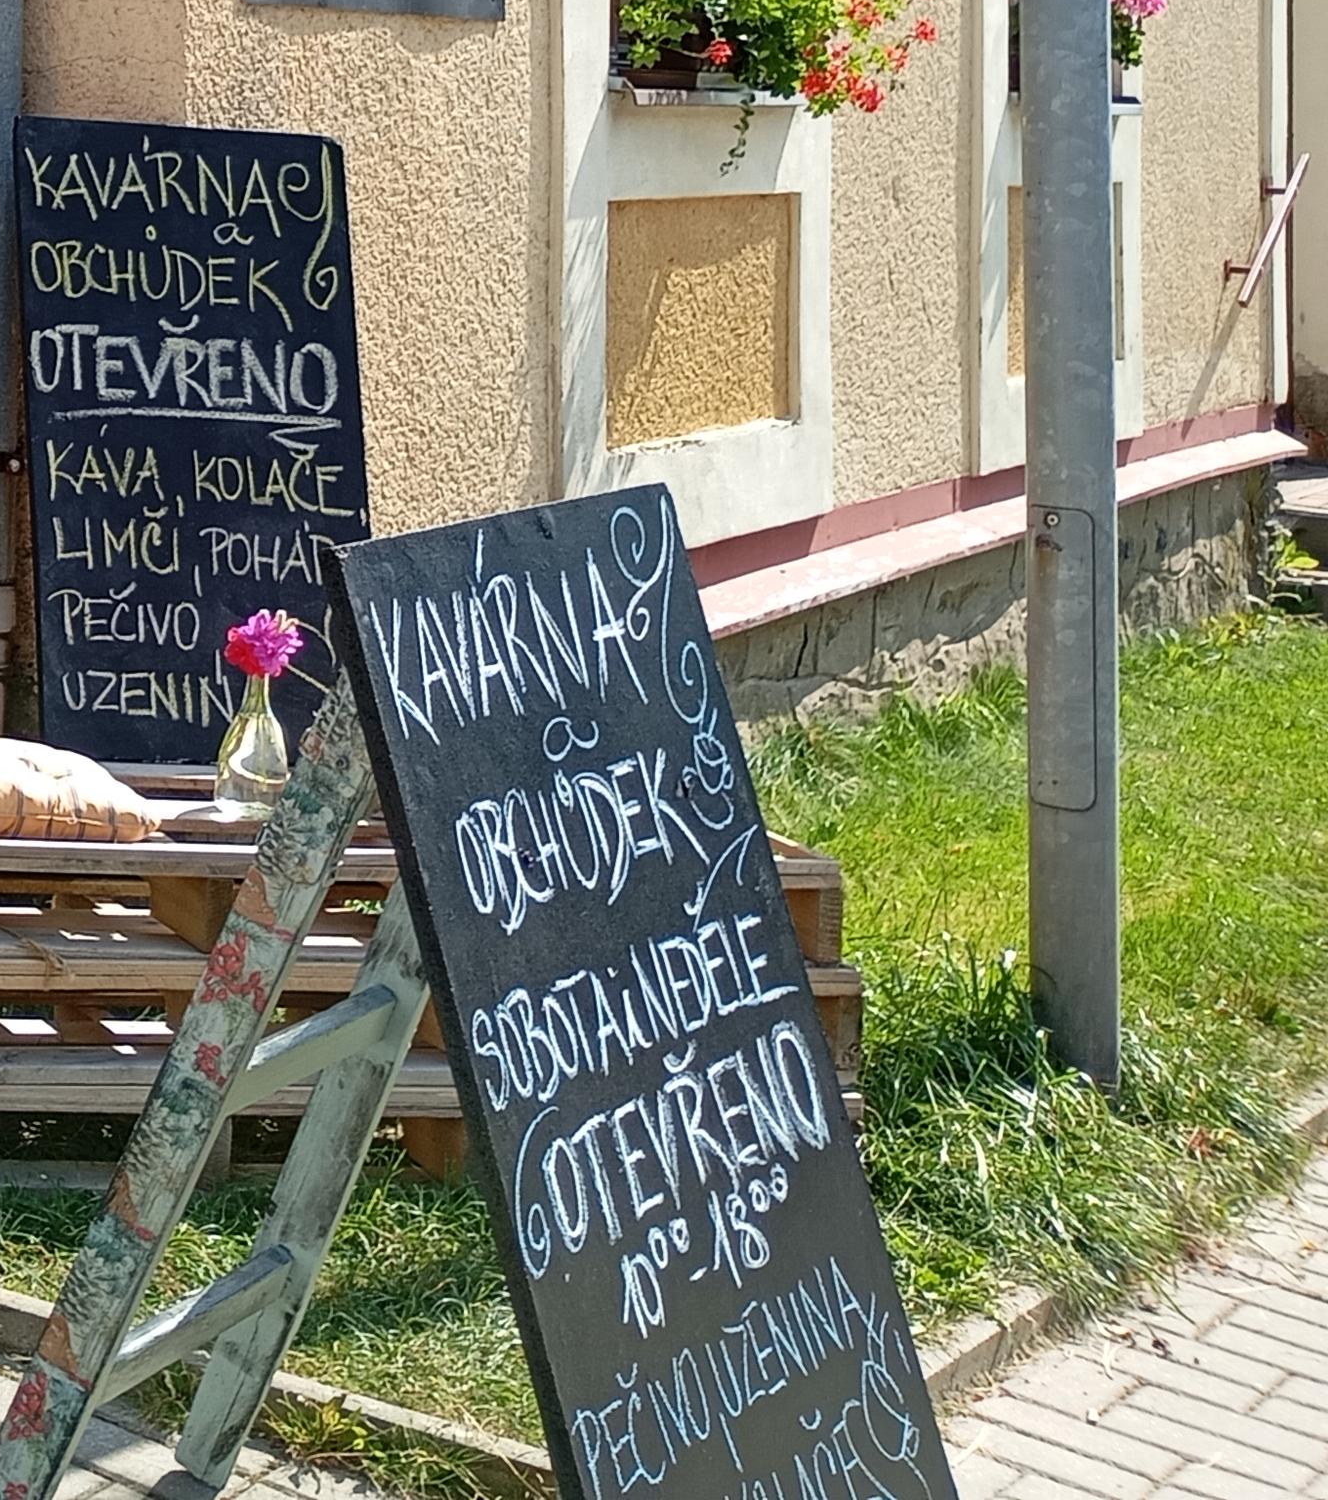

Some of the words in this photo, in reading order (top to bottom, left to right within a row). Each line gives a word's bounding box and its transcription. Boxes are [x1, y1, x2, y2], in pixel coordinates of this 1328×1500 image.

[24, 136, 282, 236] KAVÁRNA
[30, 223, 293, 332] OBCHŮDEK
[29, 314, 339, 415] OTEVŘENO
[369, 527, 650, 747] KAVÁRNA
[454, 747, 711, 937] OBCHŮDEK
[541, 1019, 832, 1254] OTEVŘENO
